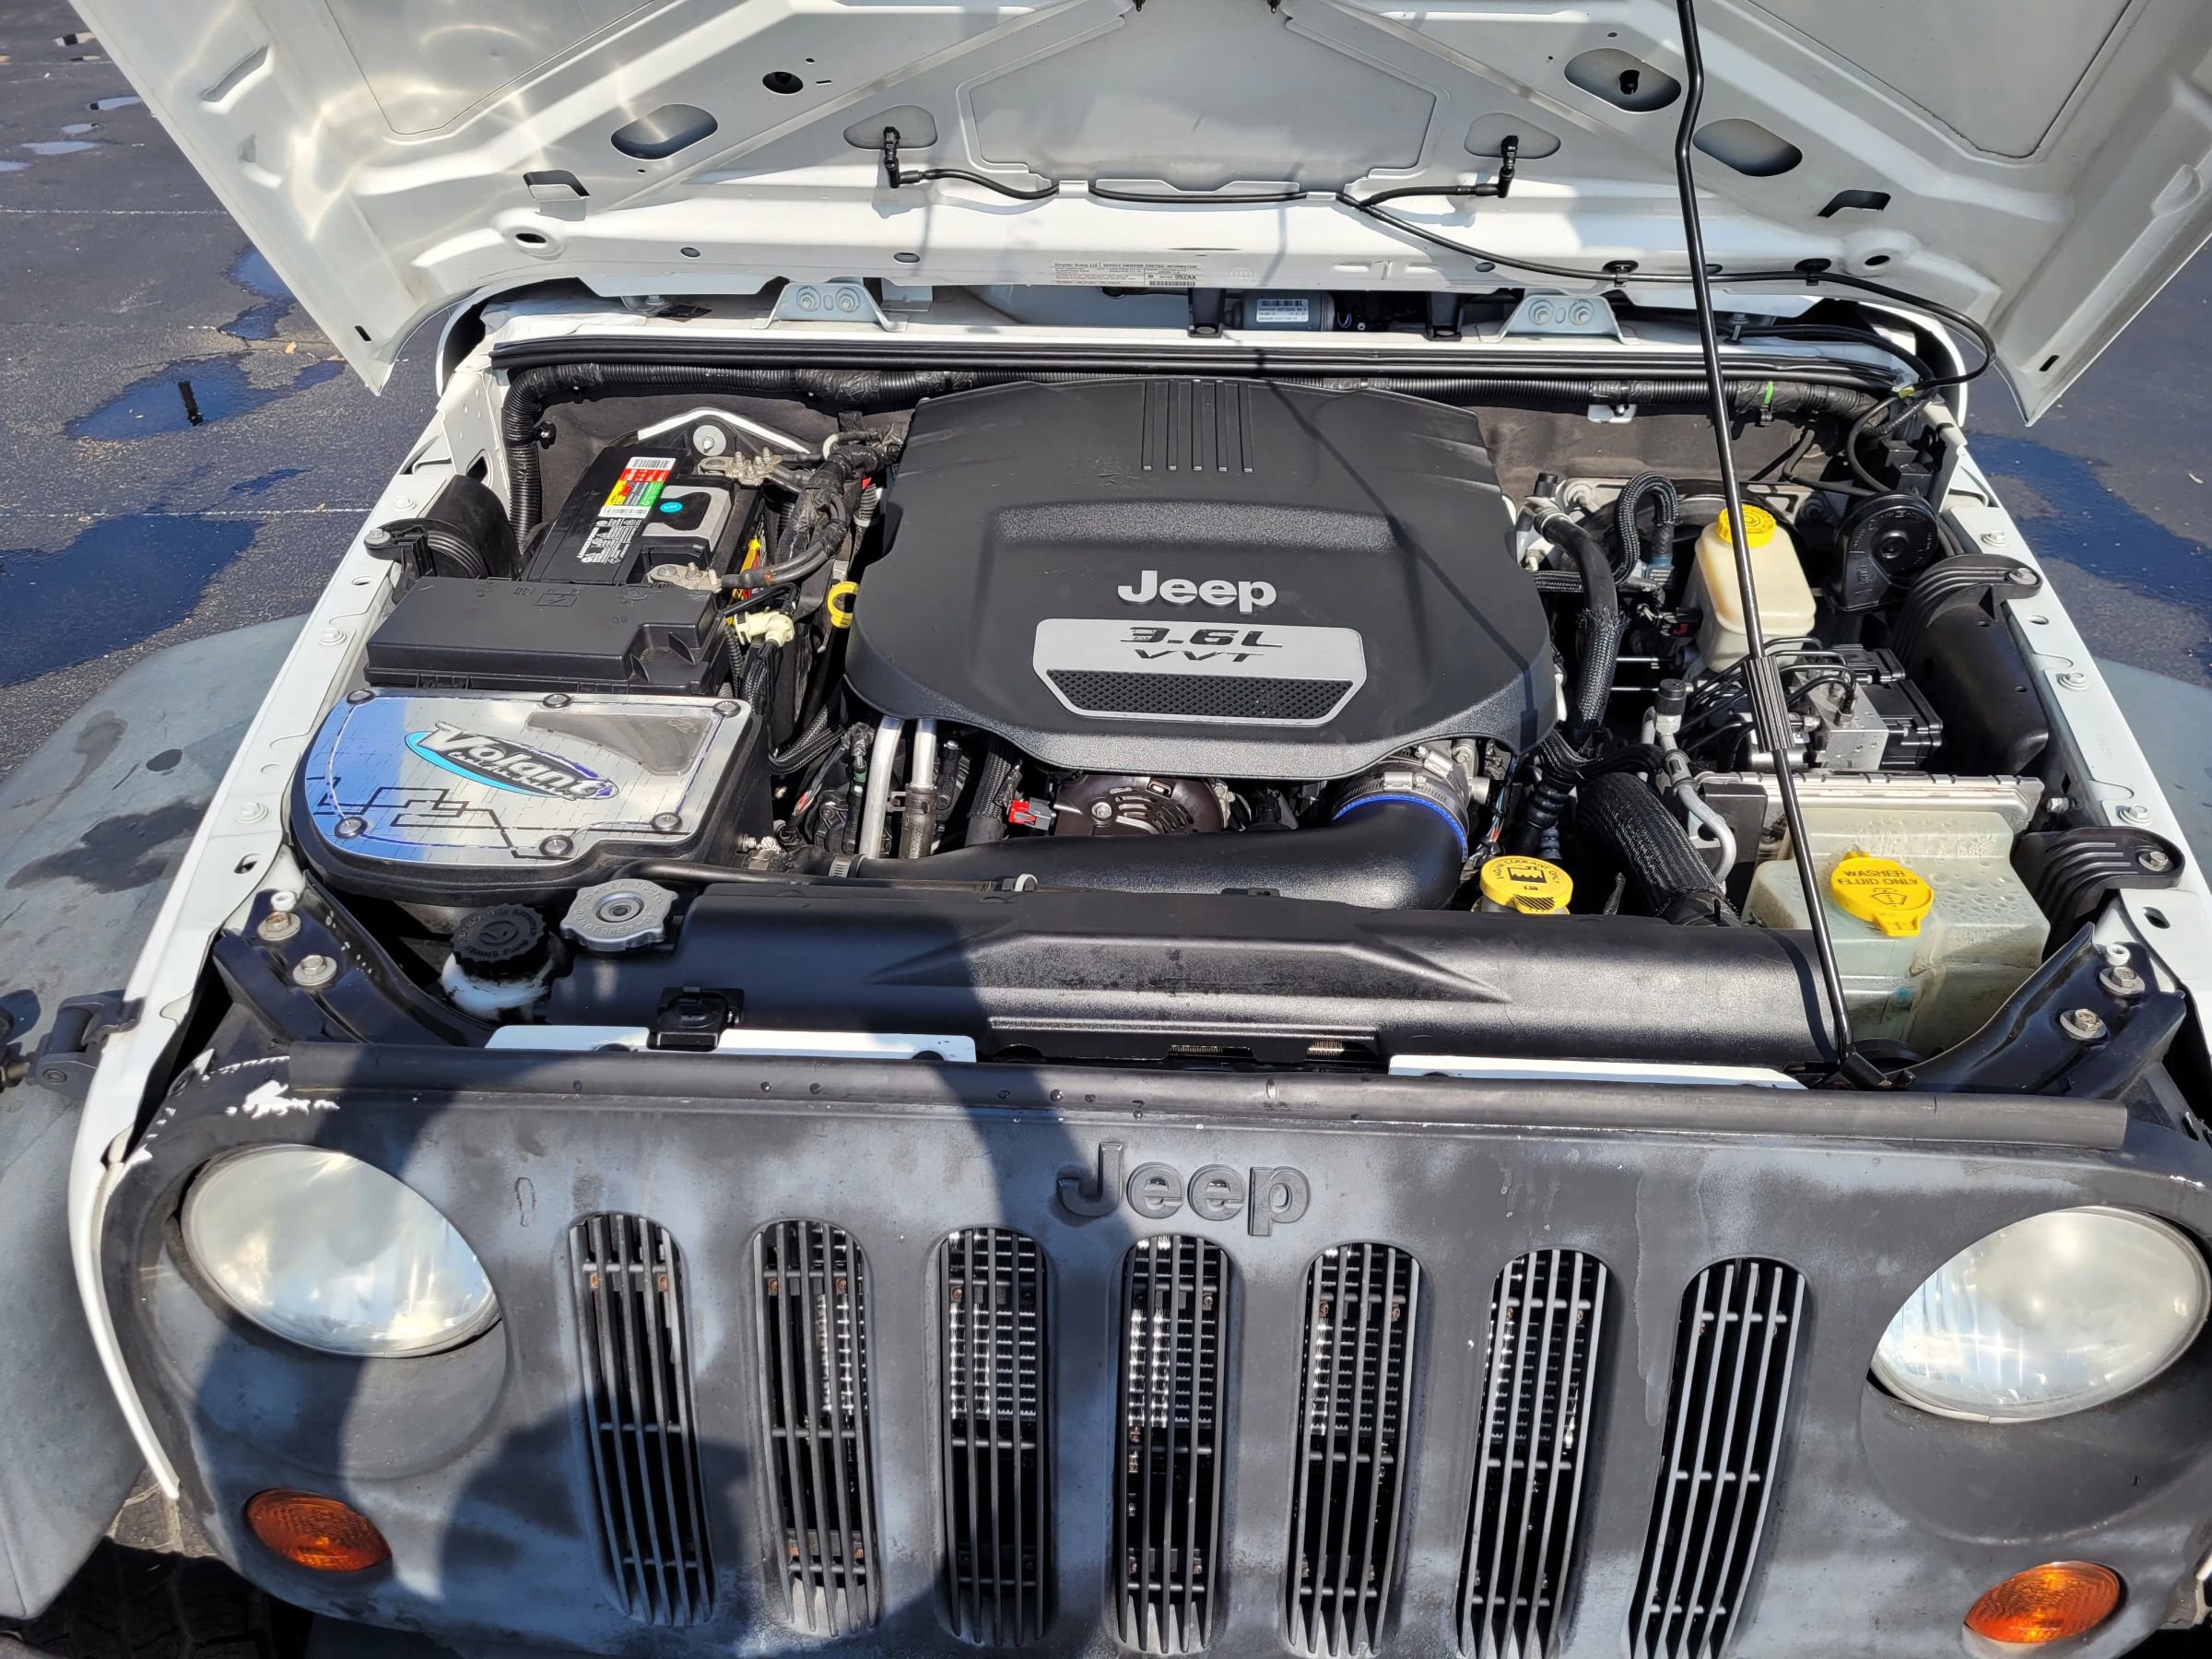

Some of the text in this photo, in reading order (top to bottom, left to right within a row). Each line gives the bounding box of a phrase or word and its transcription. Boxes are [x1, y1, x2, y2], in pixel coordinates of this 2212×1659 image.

[1117, 570, 1277, 615] Jeep
[1120, 627, 1283, 649] 3.6L
[1135, 649, 1265, 663] VVT
[417, 722, 608, 798] Volant
[1843, 869, 1905, 877] WASHER
[601, 924, 634, 935] OPEN
[1057, 1141, 1312, 1237] Jeep
